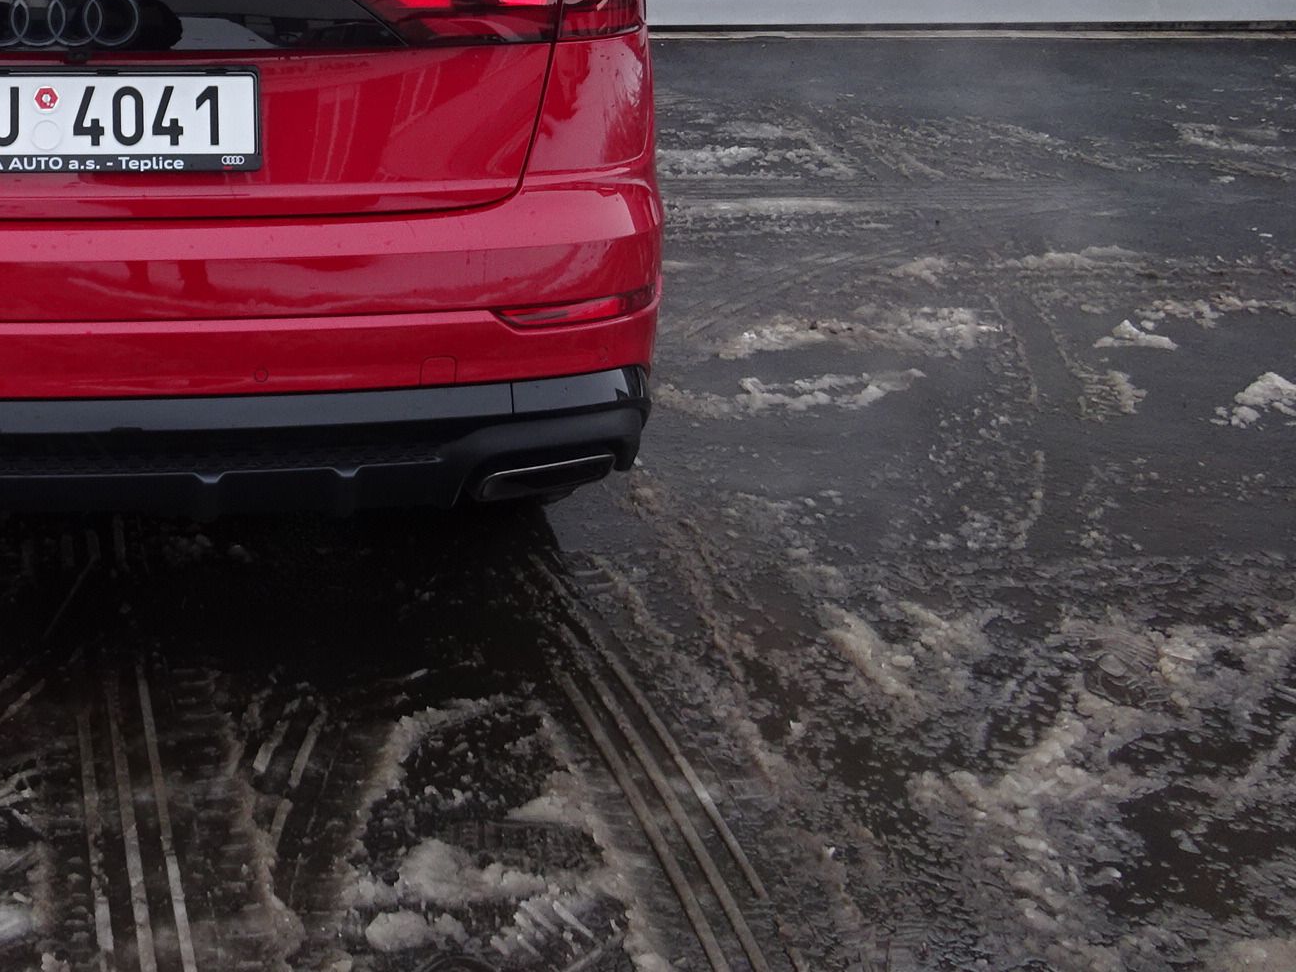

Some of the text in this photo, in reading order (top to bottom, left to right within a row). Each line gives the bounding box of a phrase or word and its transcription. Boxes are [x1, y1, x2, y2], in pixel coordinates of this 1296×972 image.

[73, 85, 220, 146] 4041
[8, 157, 63, 170] AUTO
[68, 158, 101, 170] a.s.
[118, 156, 184, 171] Teplice
